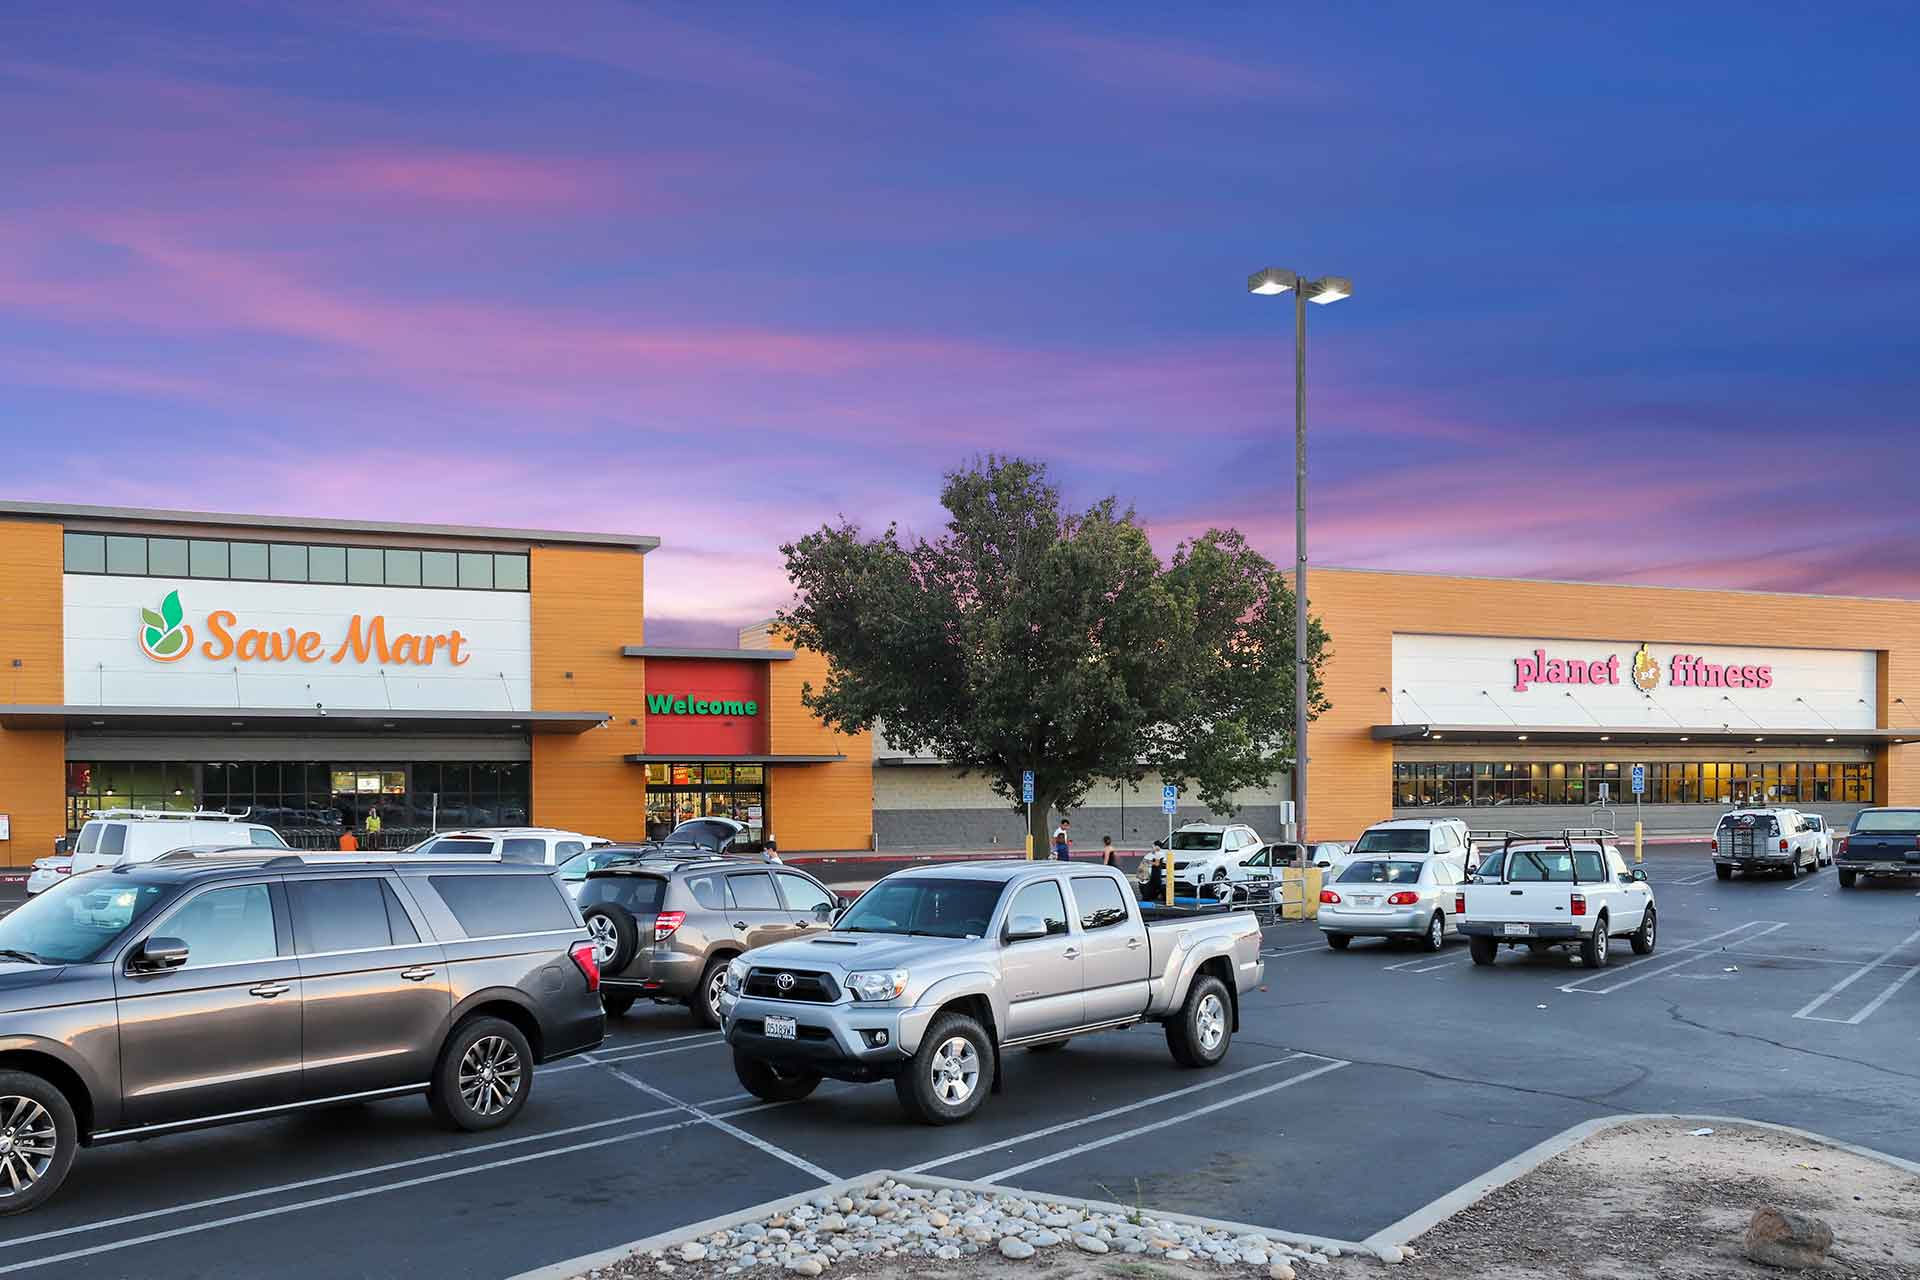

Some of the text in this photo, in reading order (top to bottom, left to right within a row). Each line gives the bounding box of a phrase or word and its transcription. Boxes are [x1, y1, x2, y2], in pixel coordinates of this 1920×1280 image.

[201, 610, 471, 667] Save Mart
[1514, 648, 1774, 692] planet pf fitness
[648, 694, 758, 715] Welcome
